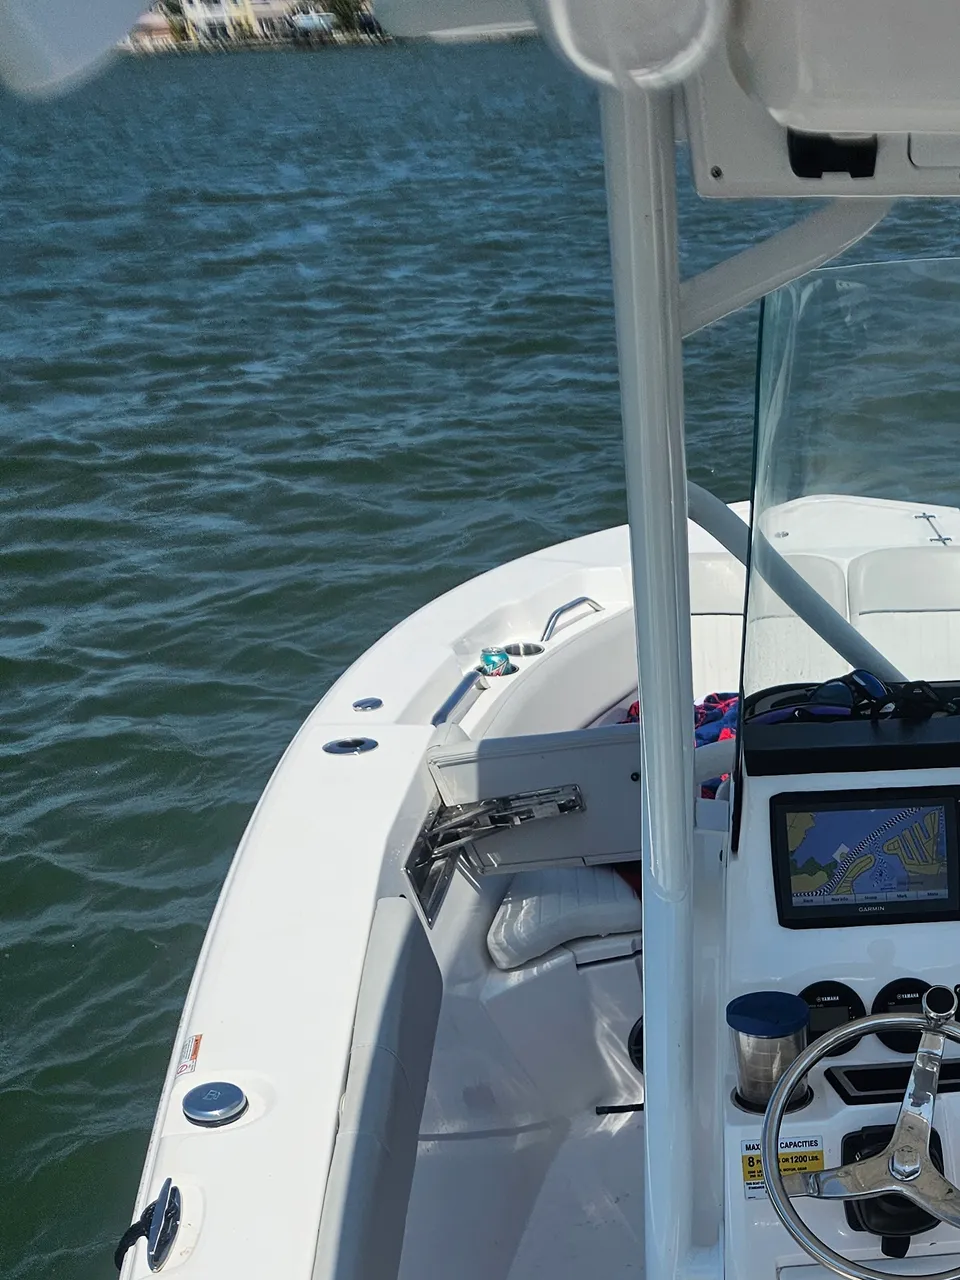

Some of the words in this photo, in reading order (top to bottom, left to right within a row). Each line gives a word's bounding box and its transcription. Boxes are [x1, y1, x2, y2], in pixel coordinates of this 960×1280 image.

[858, 905, 885, 913] GARMIN
[780, 1140, 819, 1149] CAPACITIES
[747, 1156, 755, 1167] 8
[790, 1155, 808, 1163] 1200
